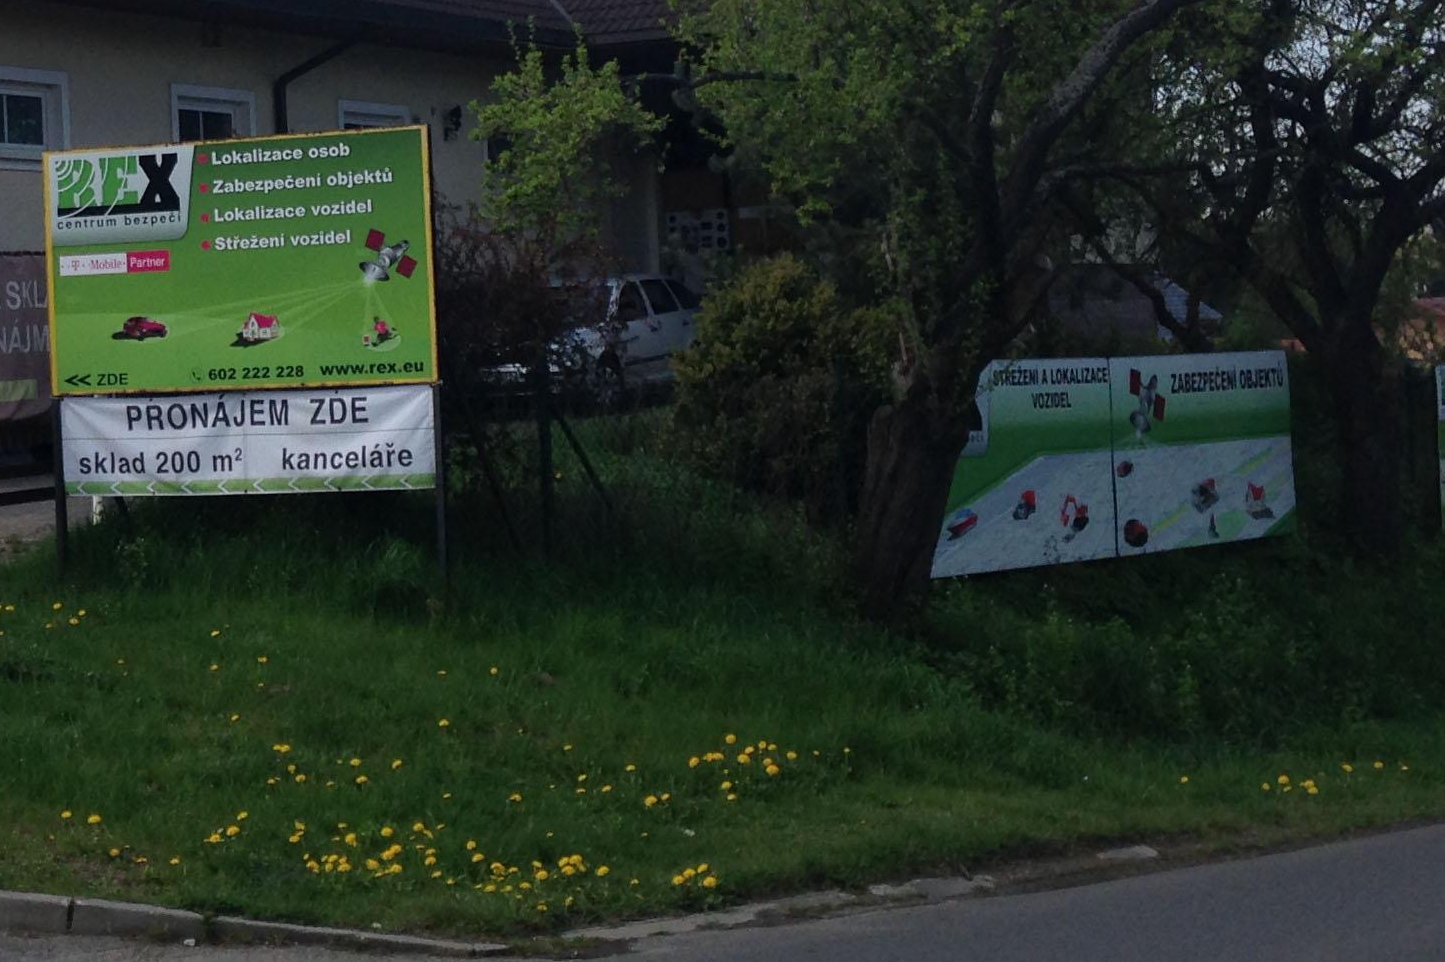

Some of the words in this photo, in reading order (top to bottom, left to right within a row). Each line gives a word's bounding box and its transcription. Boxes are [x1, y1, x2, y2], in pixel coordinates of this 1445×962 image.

[211, 147, 303, 166] Lokalizace
[308, 143, 351, 159] osob
[55, 153, 180, 214] REX
[212, 173, 322, 194] Zabezpečení
[326, 167, 393, 189] objektů
[57, 217, 117, 230] centrum
[124, 213, 181, 227] bezpečí
[214, 205, 306, 223] Lokalizace
[311, 199, 373, 216] vozidel
[214, 233, 285, 251] Střežení
[290, 229, 351, 245] vozidel
[130, 257, 165, 268] Partner
[96, 374, 129, 387] ZDE
[208, 368, 237, 381] 602
[242, 366, 271, 380] 222
[275, 365, 304, 379] 228
[319, 361, 425, 376] www.rex.eu
[1042, 369, 1048, 385] A
[1051, 367, 1108, 385] LOKALIZACE
[1171, 366, 1237, 394] ZABEZPEČENÍ
[1240, 361, 1283, 389] OBJEKTŮ
[1032, 392, 1071, 409] VOZIDEL
[126, 395, 289, 431] PRONÁJEM
[310, 397, 369, 425] ZDE
[79, 451, 145, 474] sklad
[155, 450, 201, 474] 200
[282, 442, 413, 470] kanceláře
